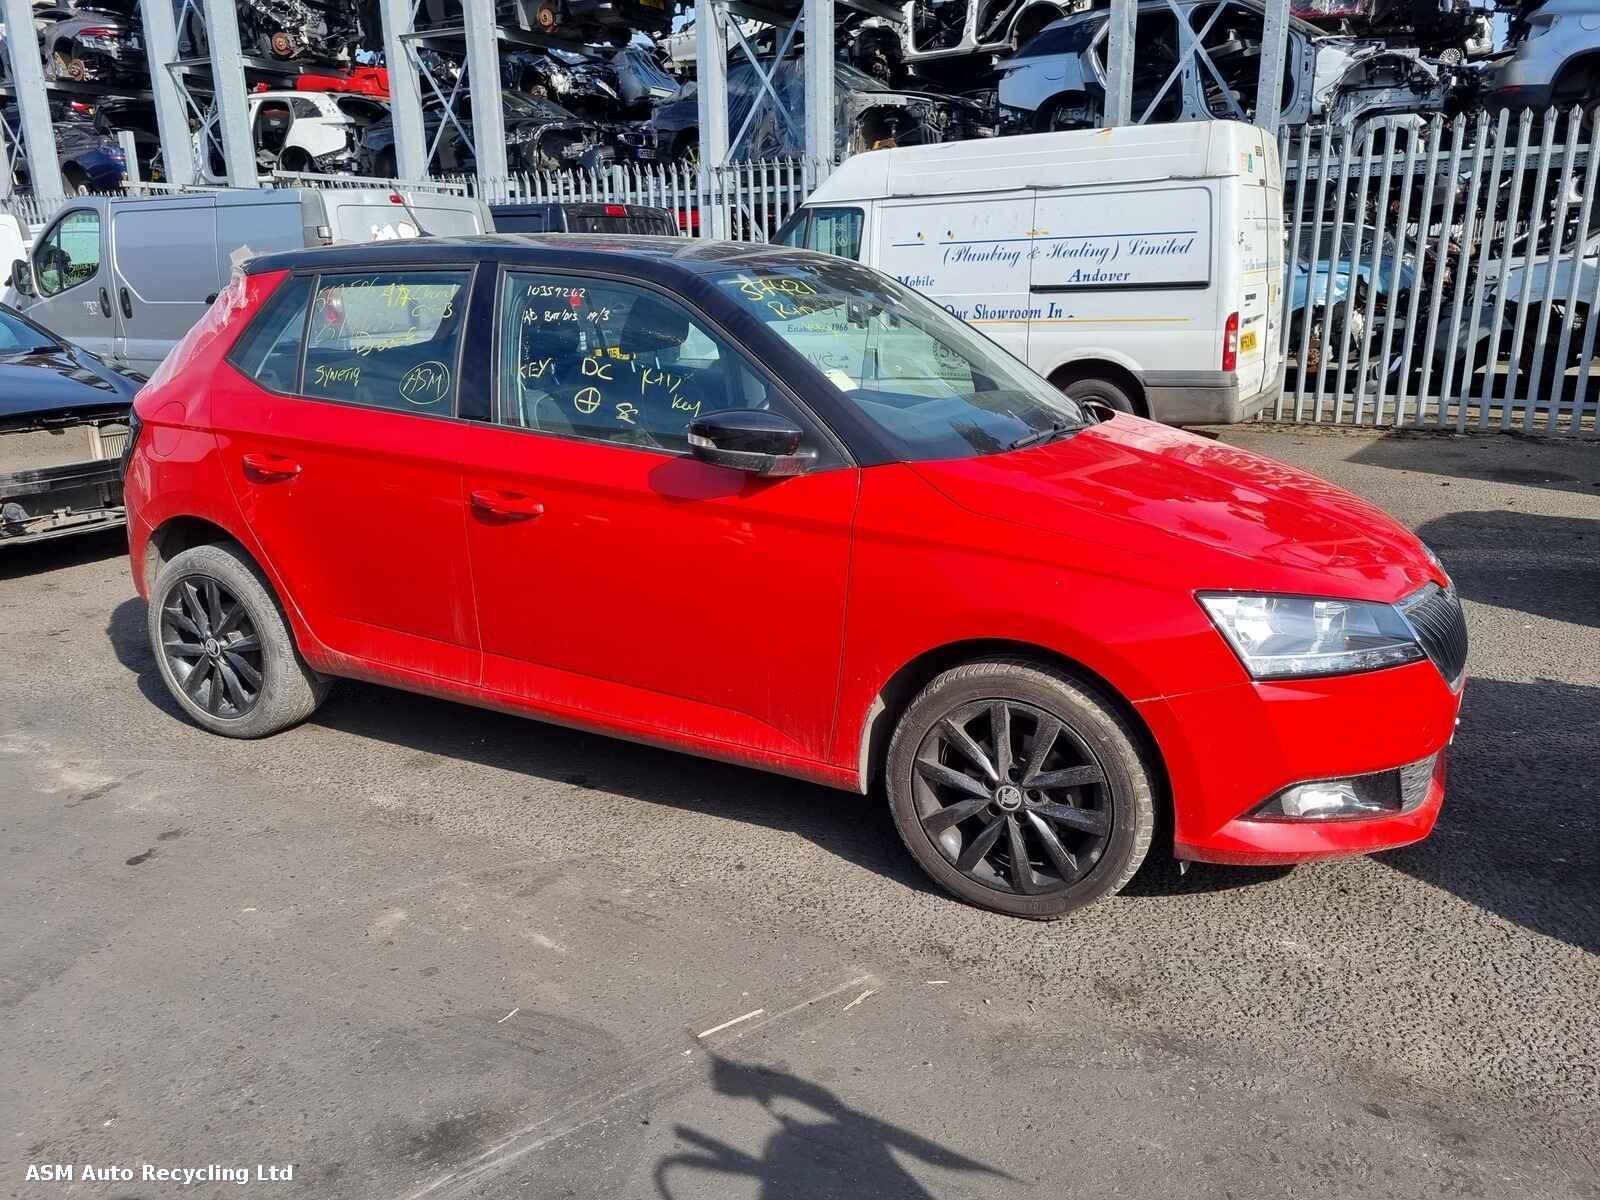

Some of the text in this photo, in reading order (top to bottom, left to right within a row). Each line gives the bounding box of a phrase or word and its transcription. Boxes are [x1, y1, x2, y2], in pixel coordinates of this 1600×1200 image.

[1026, 248, 1041, 260] &
[1128, 238, 1194, 256] Limited
[1067, 268, 1131, 283] Andover
[973, 303, 1041, 320] Showroom
[1048, 302, 1063, 319] In
[832, 322, 848, 331] 1966
